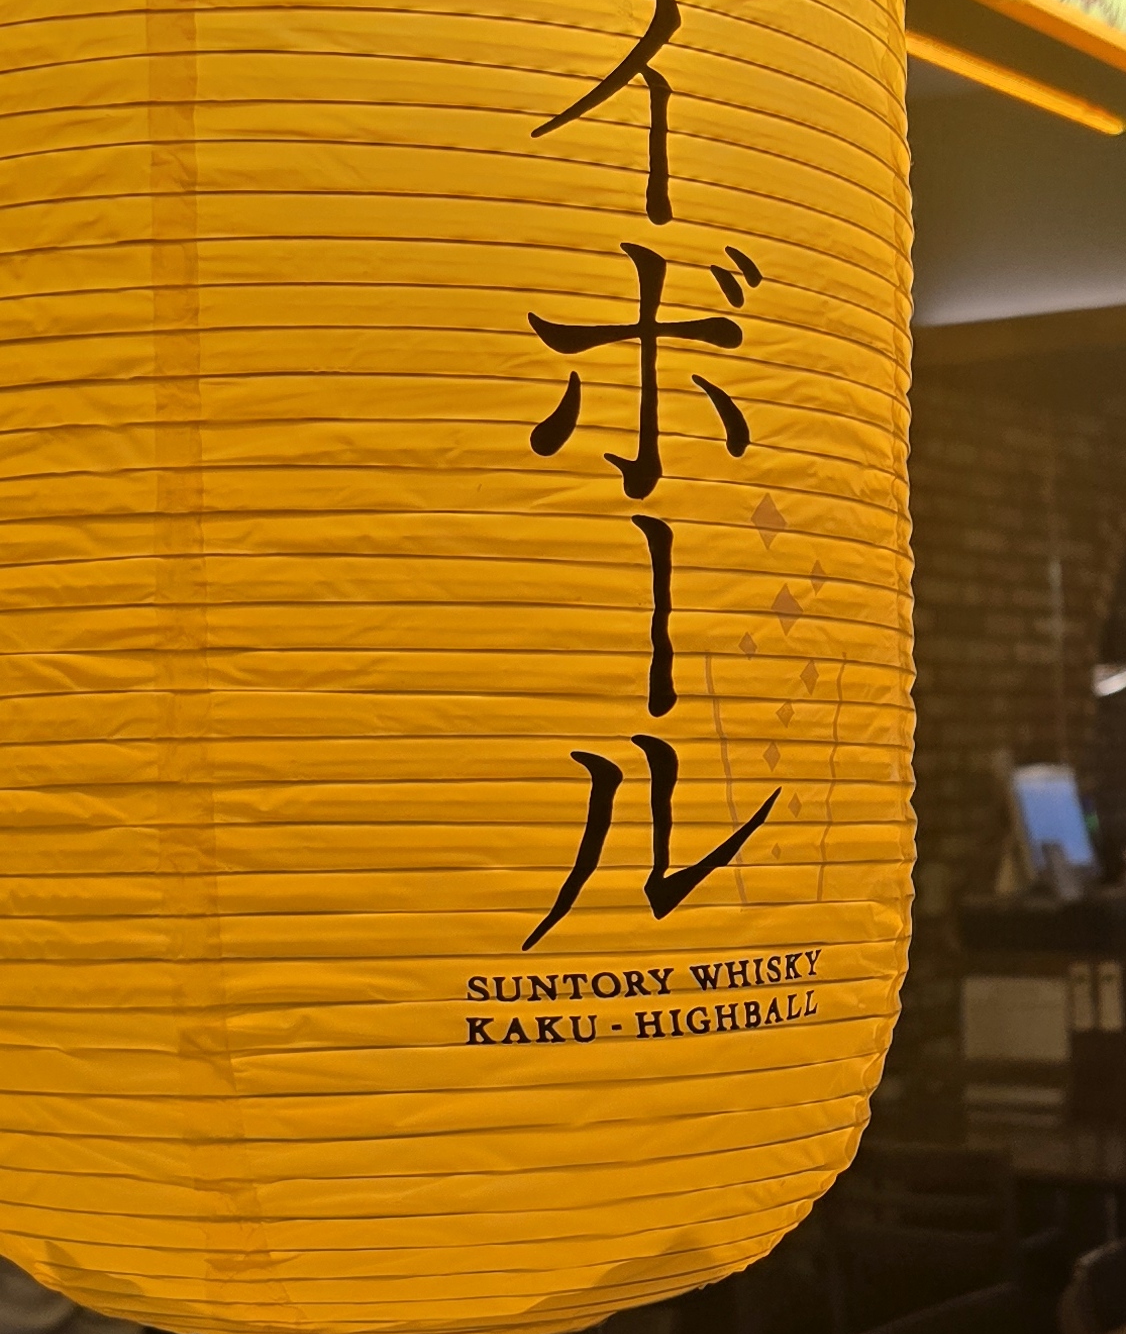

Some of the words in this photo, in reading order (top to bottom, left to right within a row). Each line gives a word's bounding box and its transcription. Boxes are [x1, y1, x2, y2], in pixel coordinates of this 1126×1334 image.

[466, 966, 676, 1003] SUNTORY
[689, 949, 823, 991] WHISKY
[465, 1013, 598, 1046] KAKU
[634, 989, 820, 1040] HIGHBALL
